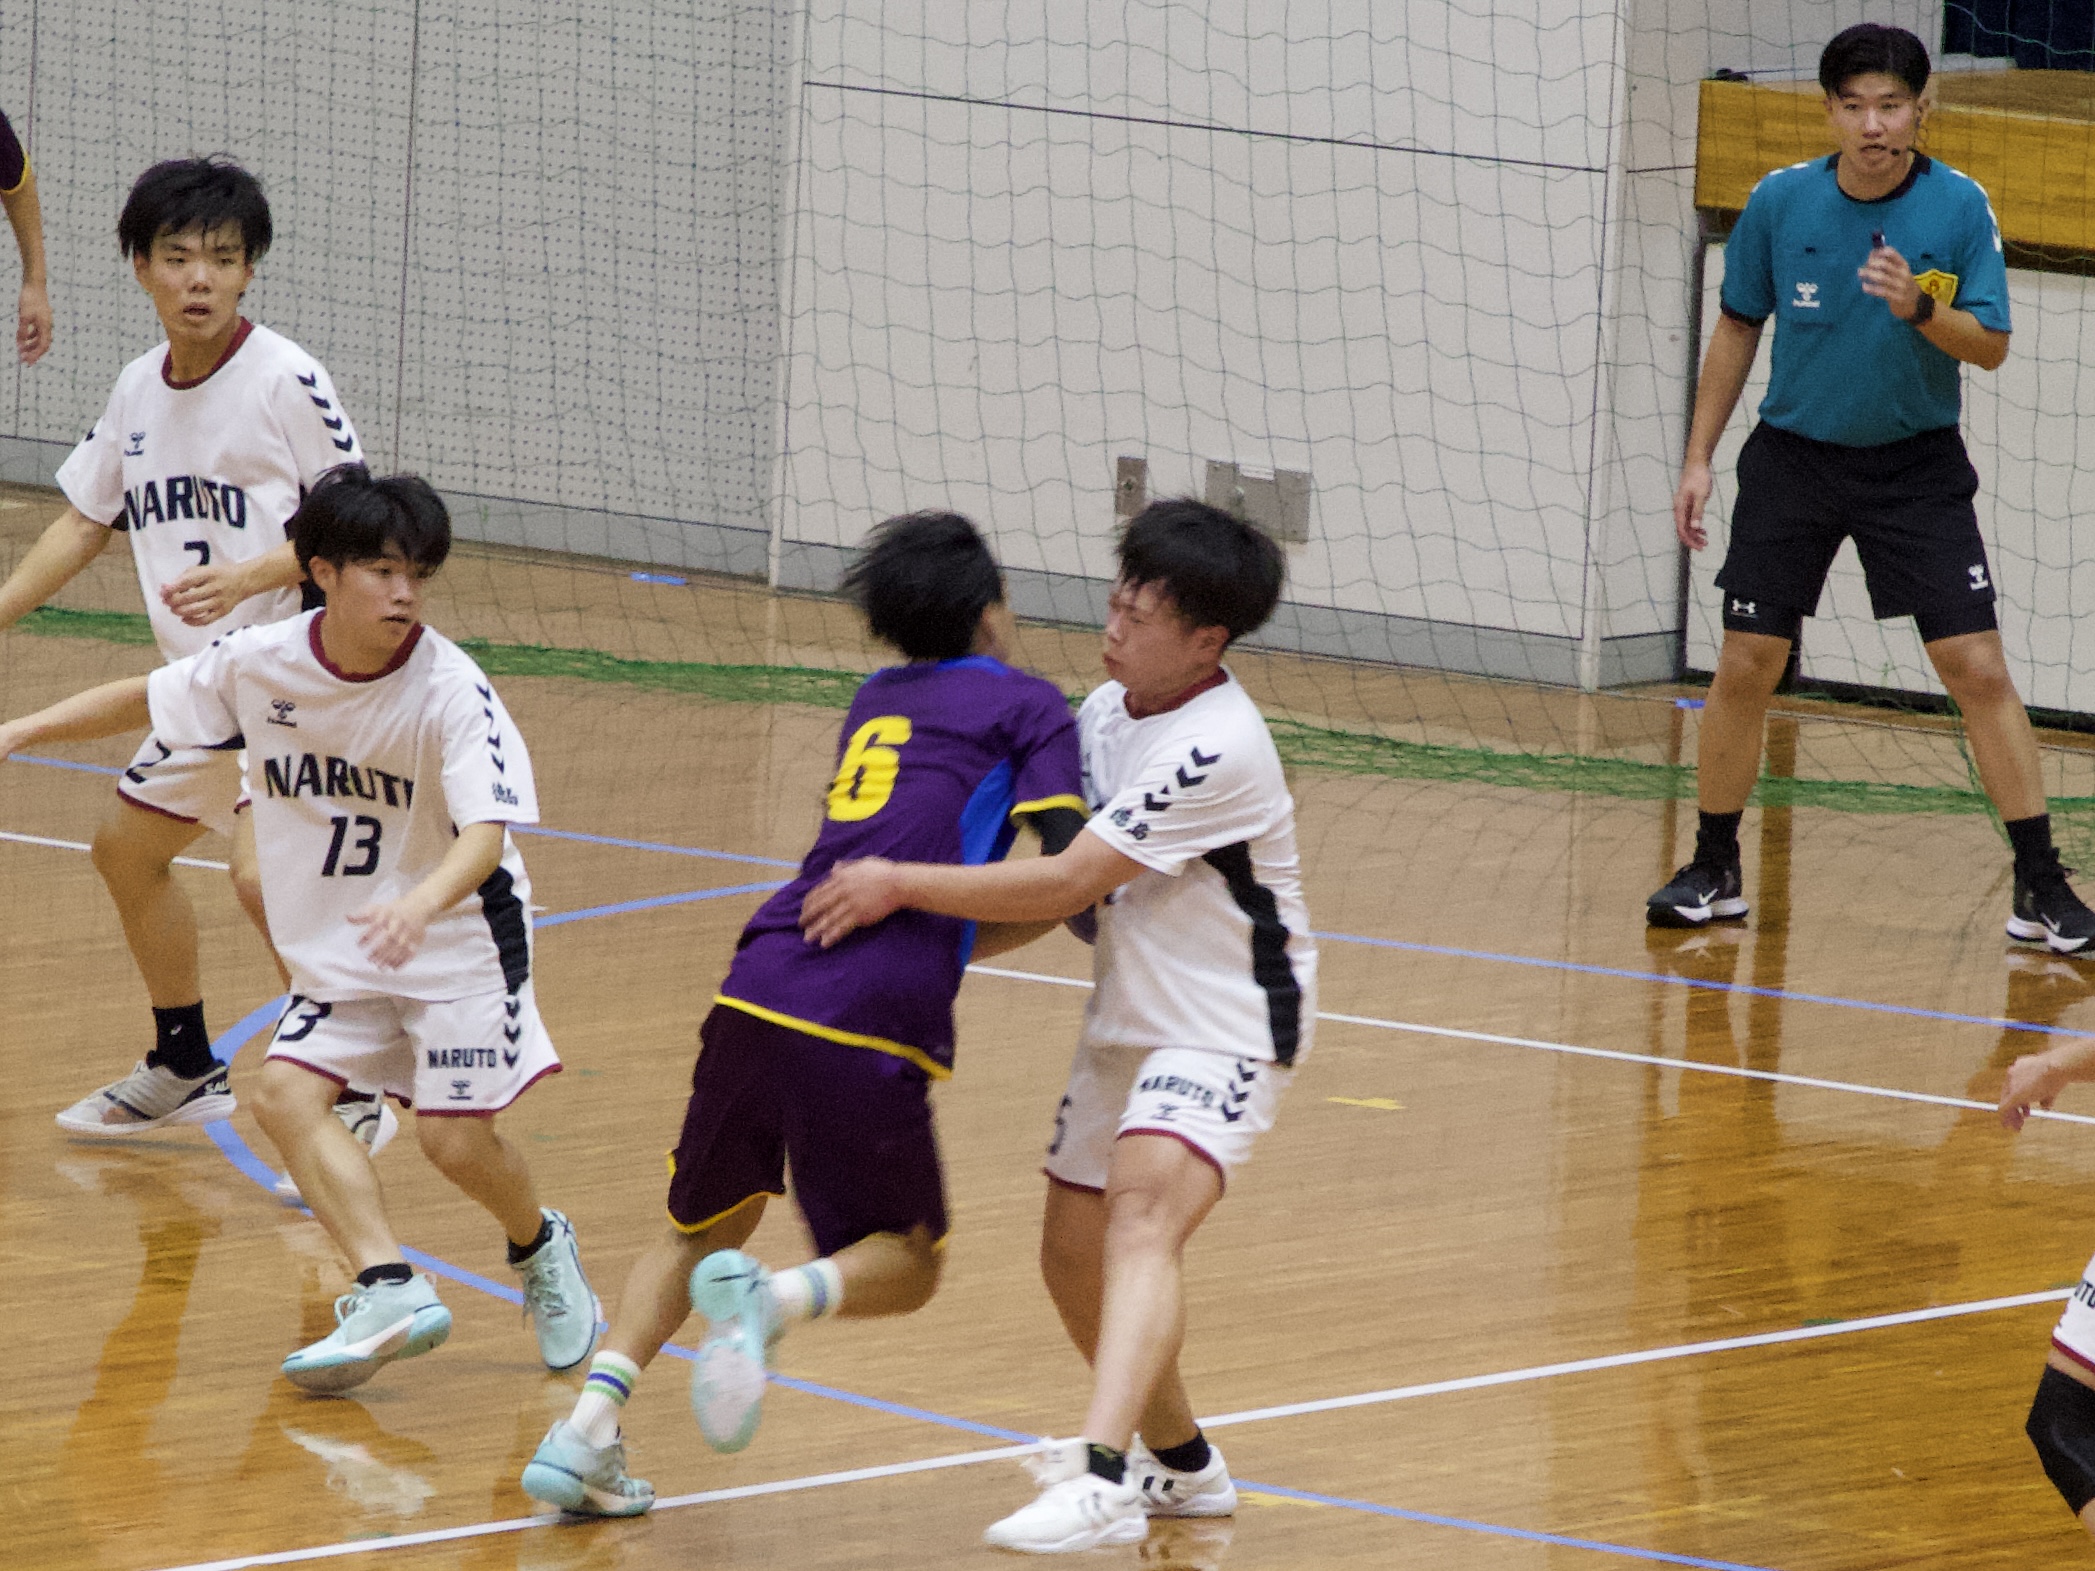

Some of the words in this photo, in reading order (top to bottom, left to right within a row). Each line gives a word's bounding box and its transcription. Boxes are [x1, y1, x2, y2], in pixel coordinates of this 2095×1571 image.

[124, 475, 246, 530] NARUTO
[827, 715, 912, 821] 6
[321, 815, 382, 876] 13
[427, 1049, 497, 1069] NARUTO
